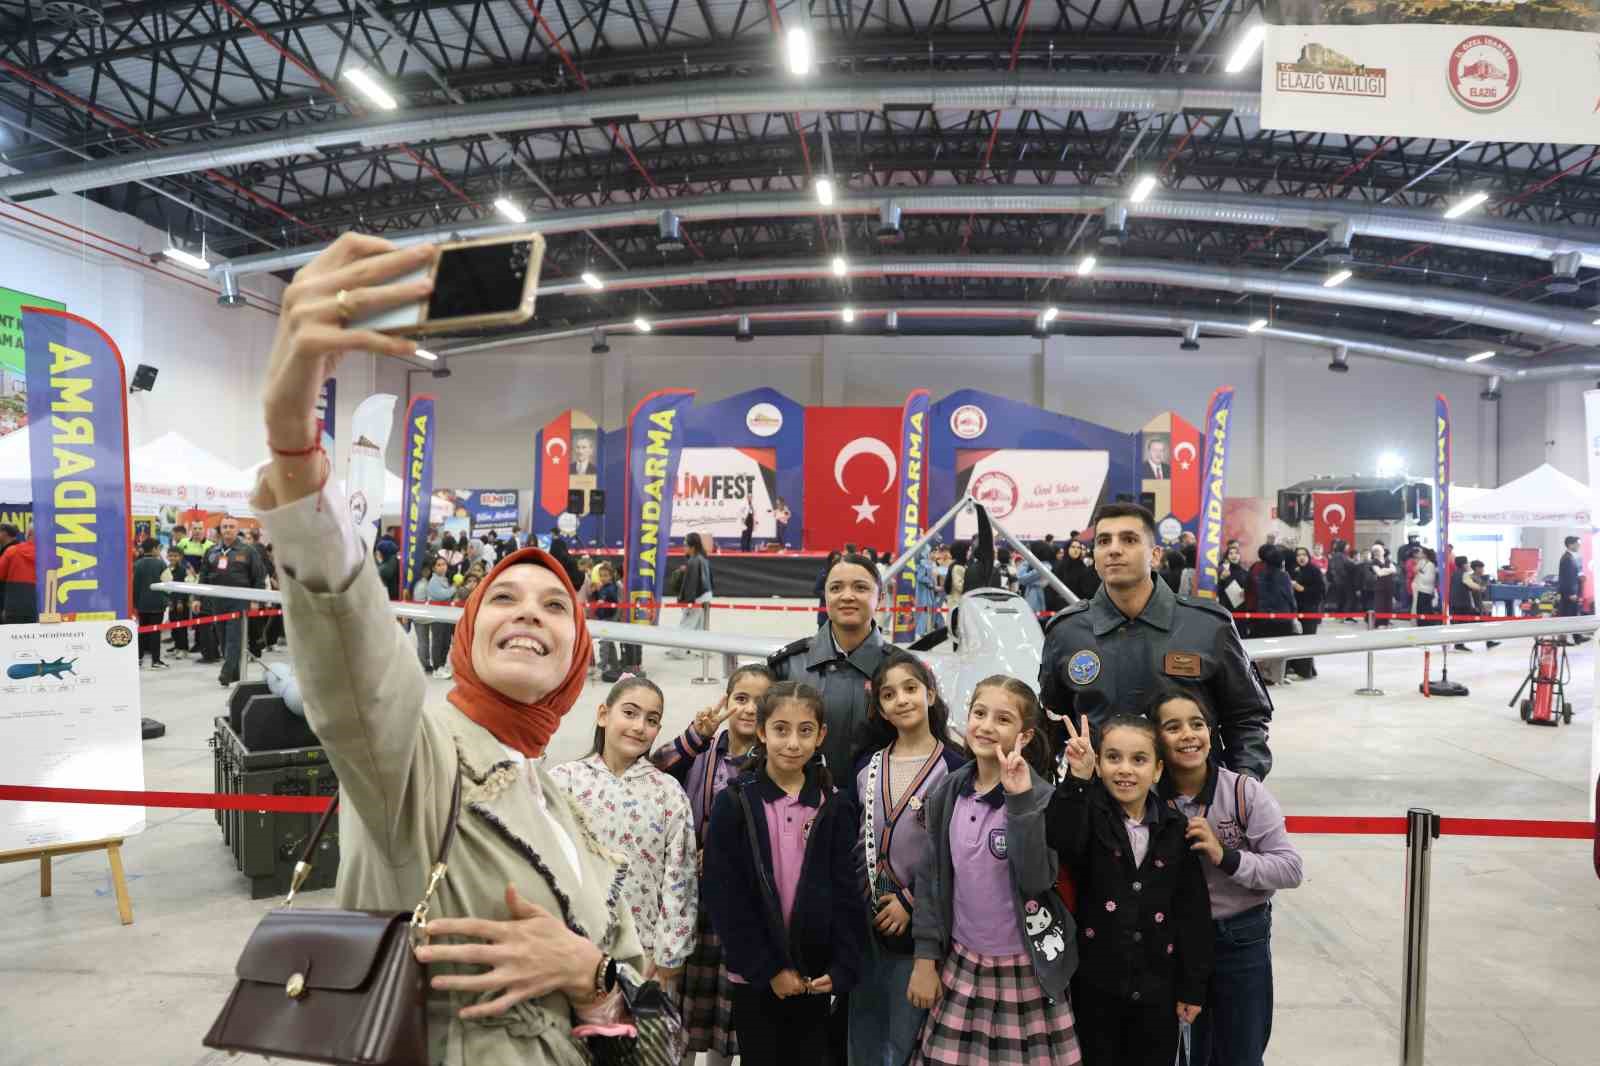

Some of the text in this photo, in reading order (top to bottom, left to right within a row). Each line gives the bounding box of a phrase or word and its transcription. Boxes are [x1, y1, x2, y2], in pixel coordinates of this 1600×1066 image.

[1280, 72, 1325, 90] ELAZIĞ
[639, 409, 676, 584] JANDARMA
[901, 411, 924, 588] JANDARMA
